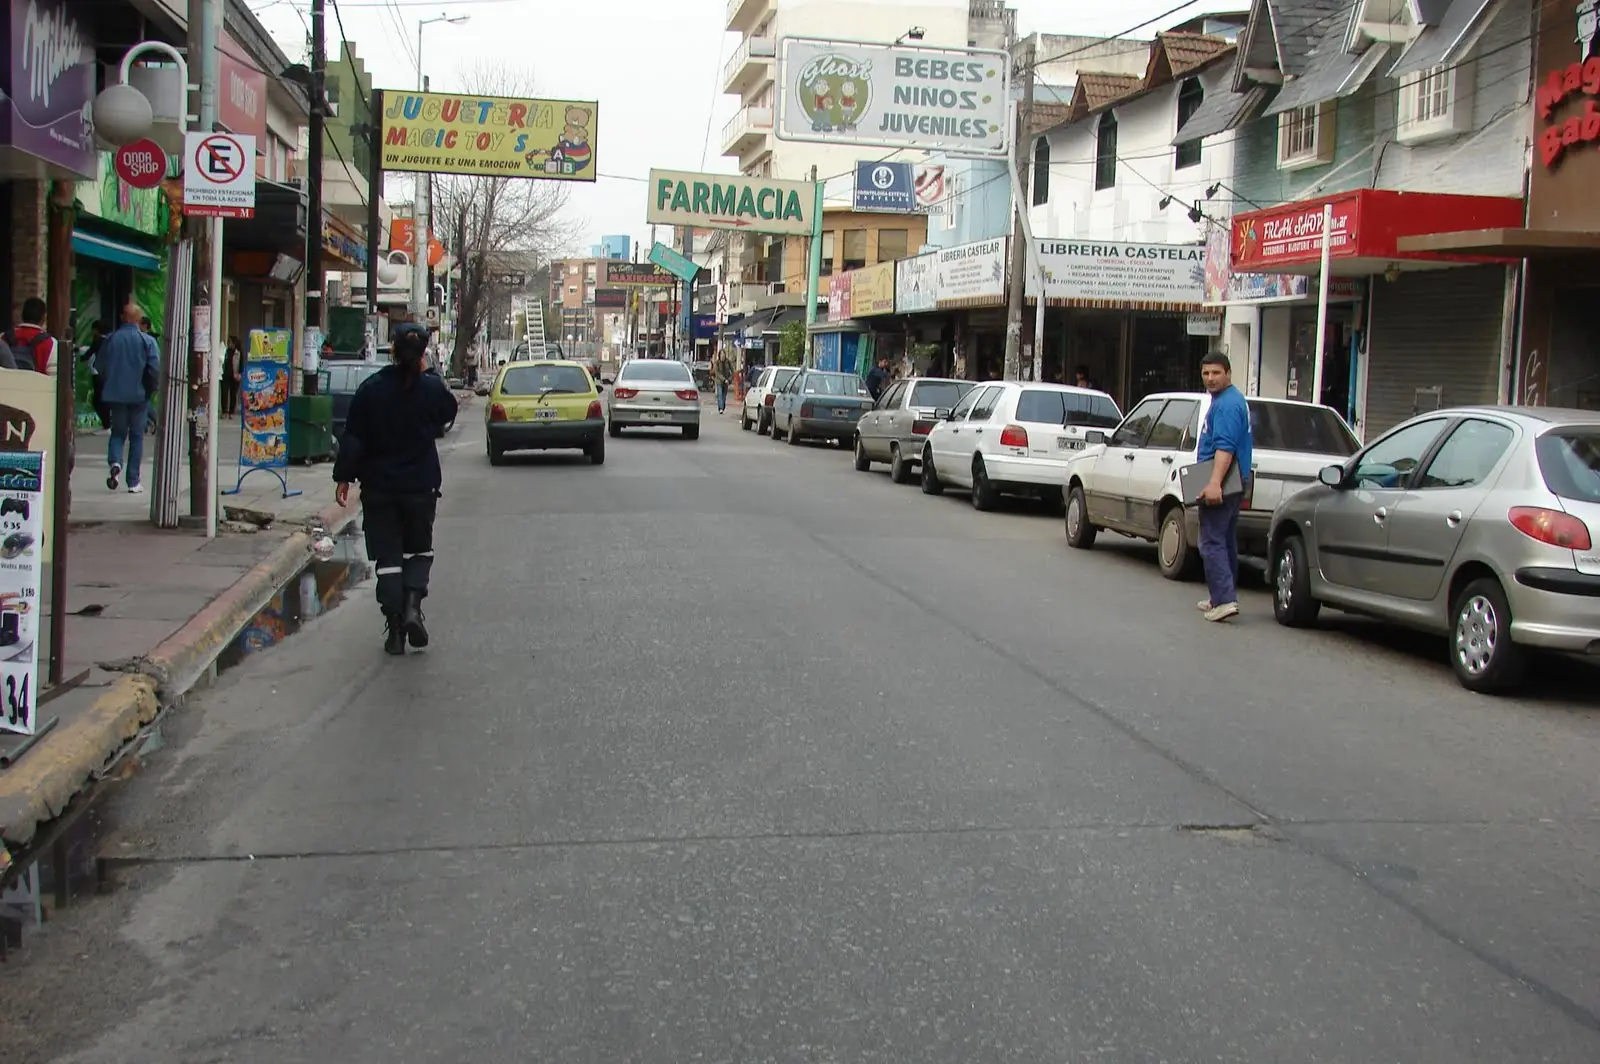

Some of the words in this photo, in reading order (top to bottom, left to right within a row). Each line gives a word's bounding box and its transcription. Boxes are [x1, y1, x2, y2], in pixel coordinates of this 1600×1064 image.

[803, 55, 873, 87] ghost
[894, 57, 984, 83] BEBES
[386, 95, 553, 129] JUGUETERIA
[879, 112, 988, 139] JUVENILES
[385, 126, 458, 149] MAGIC
[131, 161, 159, 177] SHOP
[386, 154, 399, 163] UN
[401, 155, 442, 165] JUGUETE
[445, 157, 456, 167] ES
[458, 158, 476, 167] UNA
[657, 178, 804, 222] FARMACIA
[240, 208, 249, 218] M
[941, 248, 967, 263] LIBRERIA
[967, 241, 1000, 258] CASTELAR
[1040, 243, 1119, 257] LIBRERIA
